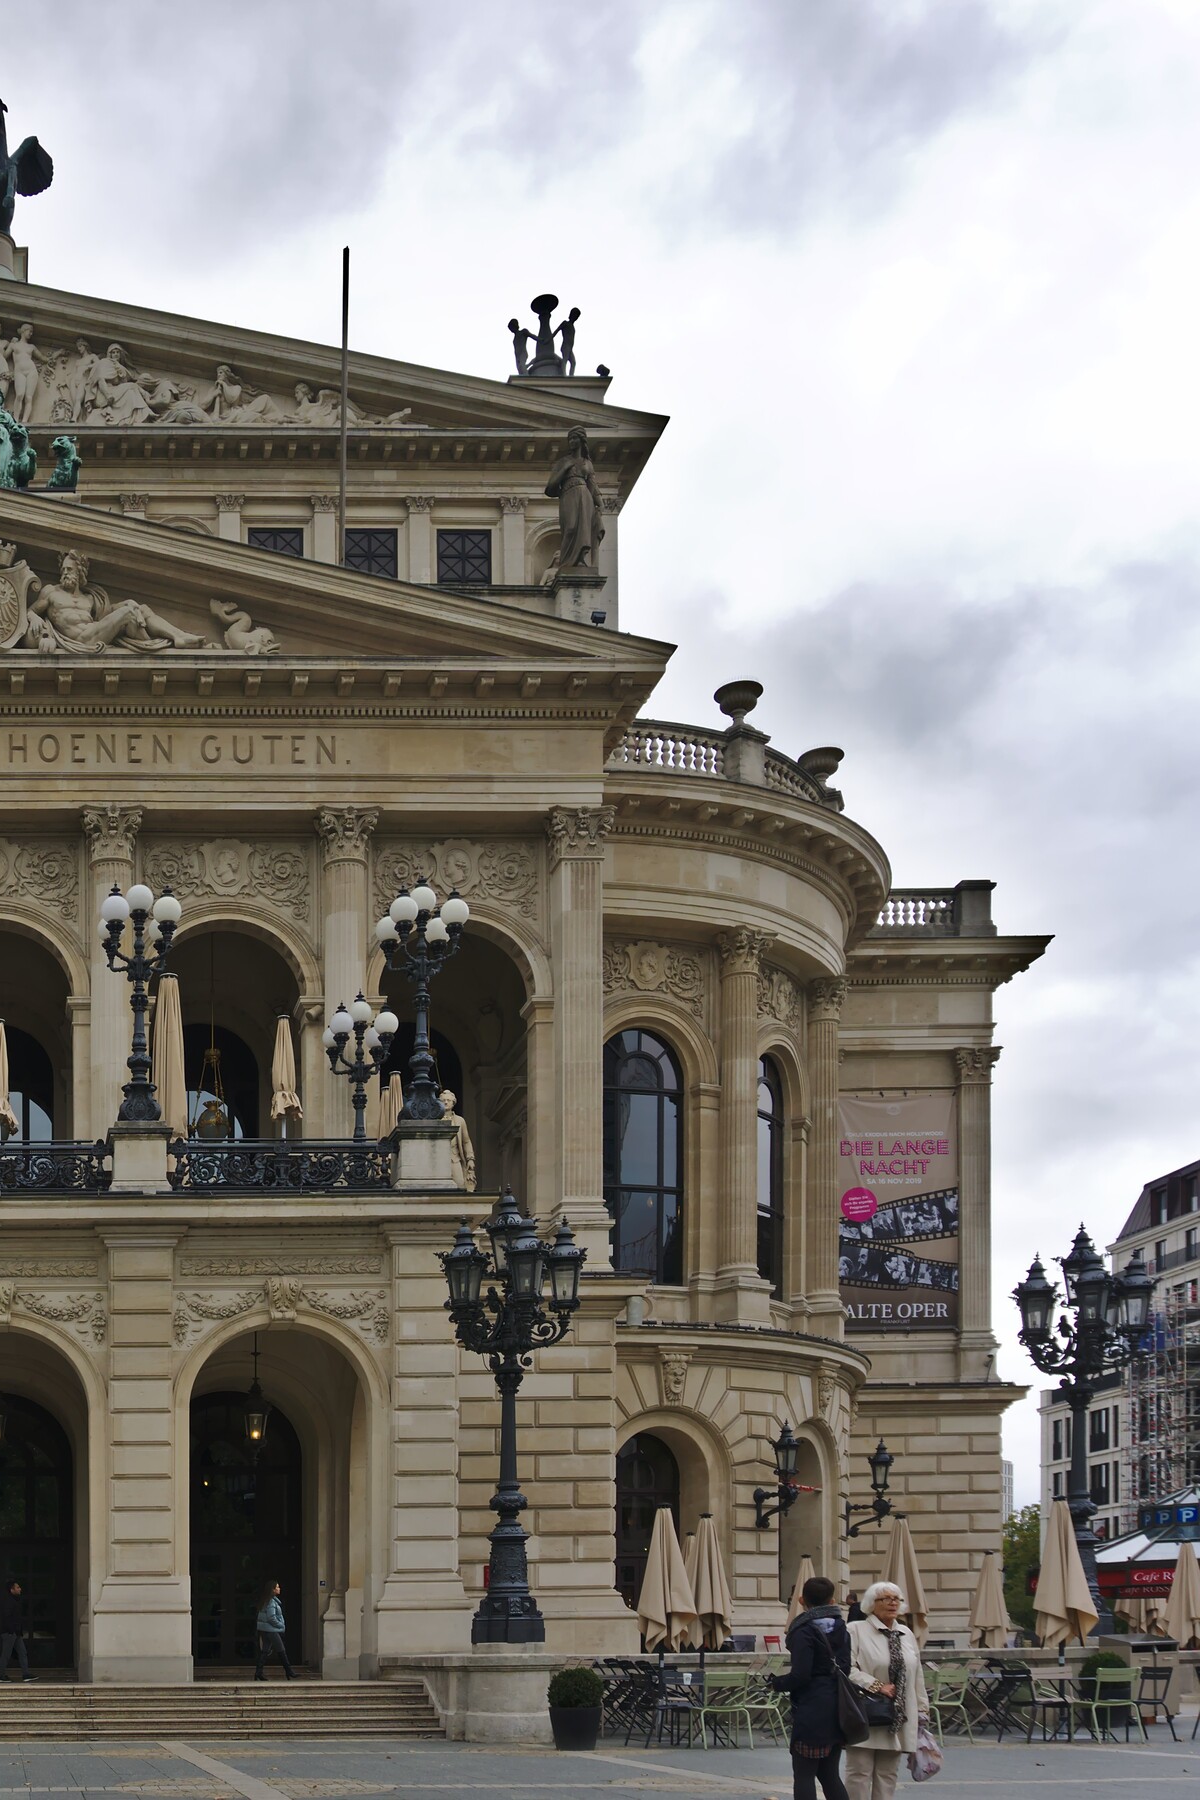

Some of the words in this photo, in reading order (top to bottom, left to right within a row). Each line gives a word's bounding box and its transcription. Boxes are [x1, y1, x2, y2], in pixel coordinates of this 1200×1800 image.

[200, 734, 351, 765] GUTEN.
[840, 1140, 874, 1156] DIE
[878, 1139, 949, 1156] LANGE
[860, 1159, 931, 1175] NACHT
[846, 1303, 893, 1319] ALTE
[897, 1303, 949, 1318] OPER
[1159, 1512, 1169, 1524] P
[1182, 1510, 1194, 1523] P
